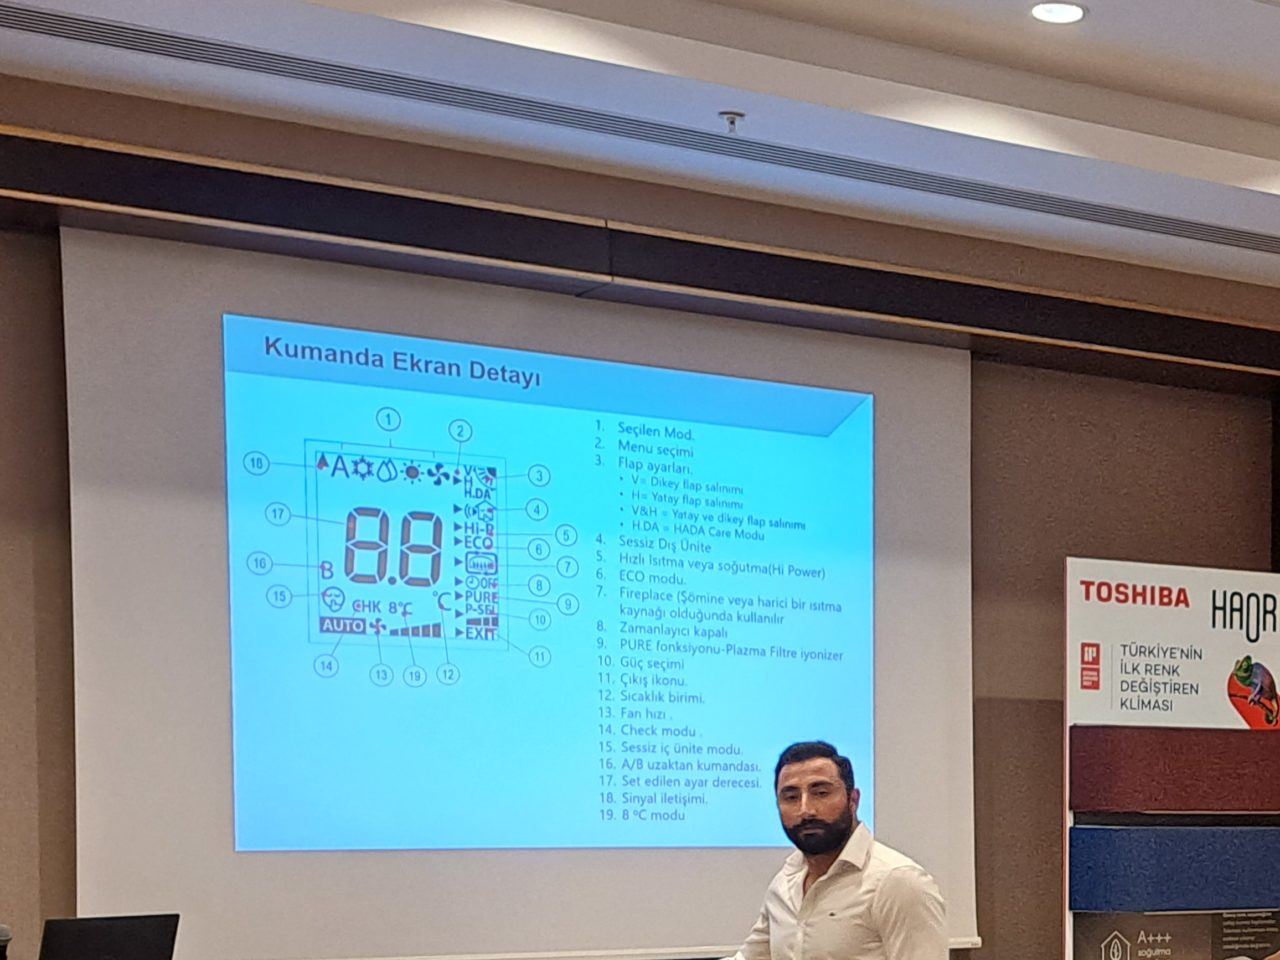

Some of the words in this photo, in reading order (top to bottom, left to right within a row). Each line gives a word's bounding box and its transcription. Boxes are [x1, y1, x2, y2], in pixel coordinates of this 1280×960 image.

[265, 336, 384, 369] Kumanda
[392, 350, 461, 378] Ekran
[469, 357, 541, 389] Detayı
[595, 419, 604, 431] 1.
[618, 422, 660, 438] Seçilen
[664, 427, 695, 441] Mod.
[595, 437, 605, 449] 2.
[618, 440, 653, 455] Menu
[657, 443, 694, 458] seçimi
[595, 455, 605, 466] 3.
[618, 456, 643, 473] Flap
[647, 460, 693, 475] ayarları.
[650, 476, 679, 490] Dikey
[683, 478, 702, 492] flap
[651, 491, 679, 505] Yatay
[682, 493, 702, 507] flap
[632, 505, 657, 517] V&H
[672, 509, 699, 522] Yatay
[702, 513, 714, 522] ve
[717, 512, 744, 527] dikey
[747, 515, 766, 528] flap
[632, 520, 659, 532] H.DA
[674, 523, 705, 536] HADA
[709, 526, 731, 538] Care
[735, 528, 765, 541] Modu
[595, 533, 605, 545] 4.
[619, 535, 654, 550] Sessiz
[658, 538, 677, 553] Dış
[680, 539, 712, 552] Ünite
[596, 551, 606, 562] 5.
[619, 552, 644, 565] Hızlı
[688, 558, 715, 572] veya
[788, 565, 826, 579] Power)
[596, 568, 606, 580] 6.
[619, 570, 644, 582] ECO
[649, 572, 686, 585] modu.
[596, 585, 606, 597] 7.
[619, 587, 673, 605] Fireplace
[677, 590, 724, 605] (Şömine
[728, 595, 754, 608] veya
[791, 597, 805, 609] bir
[1080, 580, 1190, 608] TOSHIBA
[619, 605, 666, 621] kaynağı
[670, 607, 733, 623] olduğunda
[737, 611, 784, 624] kullanılır
[597, 621, 606, 632] 8.
[619, 622, 690, 637] Zamanlayıcı
[694, 626, 728, 639] kapalı
[596, 638, 606, 649] 9.
[620, 640, 651, 650] PURE
[770, 646, 797, 658] Filtre
[1120, 642, 1203, 660] TÜRKİYE'NİN
[598, 655, 615, 667] 10.
[620, 657, 643, 671] Güç
[647, 659, 684, 671] seçimi
[1120, 658, 1140, 675] İLK
[1144, 664, 1180, 676] RENK
[598, 673, 615, 684] 11.
[620, 674, 648, 688] Çıkış
[651, 676, 687, 687] ikonu.
[1120, 678, 1199, 696] DEĞİŞTİREN
[598, 690, 615, 701] 12.
[620, 691, 664, 702] Sıcaklık
[668, 692, 705, 704] birimi.
[1120, 696, 1173, 712] KLİMASI
[599, 707, 615, 718] 13.
[621, 708, 641, 719] Fan
[599, 724, 615, 736] 14.
[621, 725, 657, 737] Check
[599, 741, 616, 752] 15.
[621, 742, 656, 753] Sessiz
[661, 742, 670, 756] iç
[674, 742, 703, 754] ünite
[707, 744, 743, 755] modu.
[599, 759, 616, 770] 16.
[621, 760, 643, 771] A/B
[648, 760, 693, 772] uzaktan
[697, 760, 761, 773] kumandası.
[599, 775, 616, 787] 17.
[622, 776, 640, 787] Set
[644, 776, 680, 788] edilen
[684, 778, 708, 790] ayar
[712, 777, 761, 789] derecesi.
[600, 792, 617, 804] 18.
[622, 793, 657, 807] Sinyal
[660, 794, 708, 807] iletişimi.
[600, 809, 617, 820] 19.
[622, 810, 629, 820] 8
[1137, 930, 1172, 943] A+++
